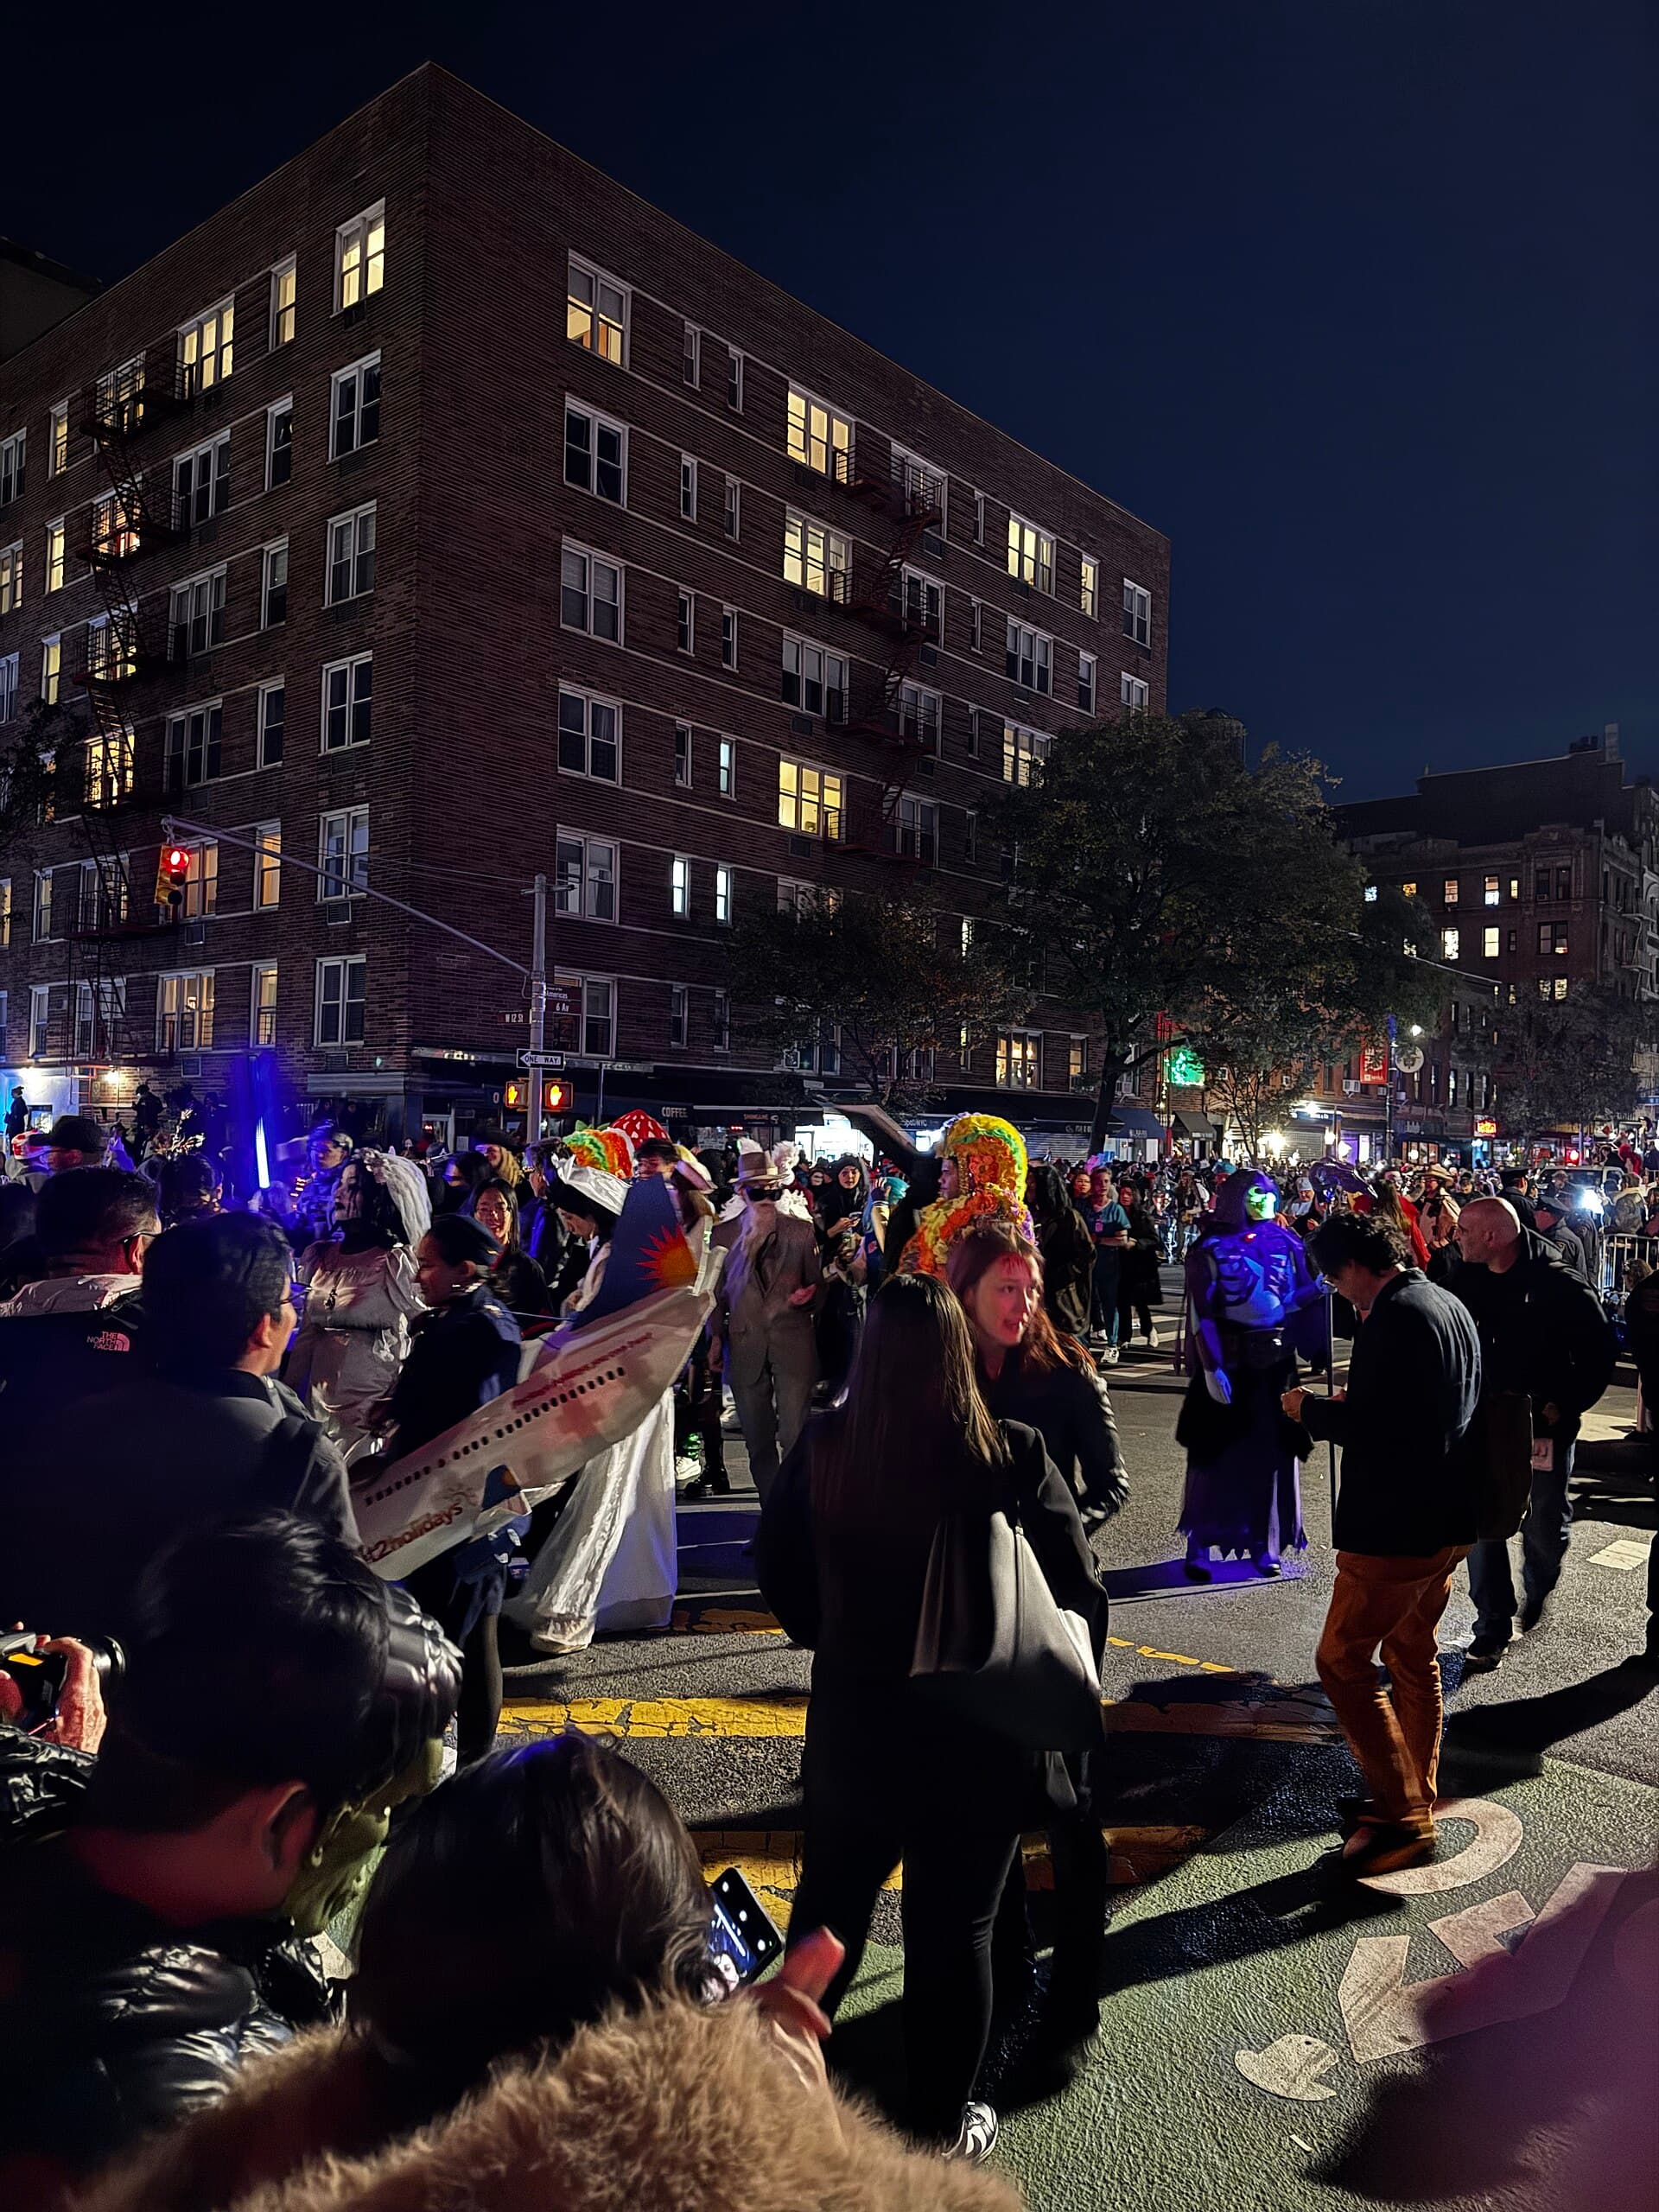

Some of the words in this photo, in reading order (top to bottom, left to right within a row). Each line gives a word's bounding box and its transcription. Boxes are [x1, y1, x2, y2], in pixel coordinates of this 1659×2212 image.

[556, 1002, 560, 1012] 6
[512, 1014, 517, 1023] 12
[662, 1106, 689, 1118] COFFEE
[102, 1331, 118, 1339] THE
[86, 1336, 117, 1344] NORTH
